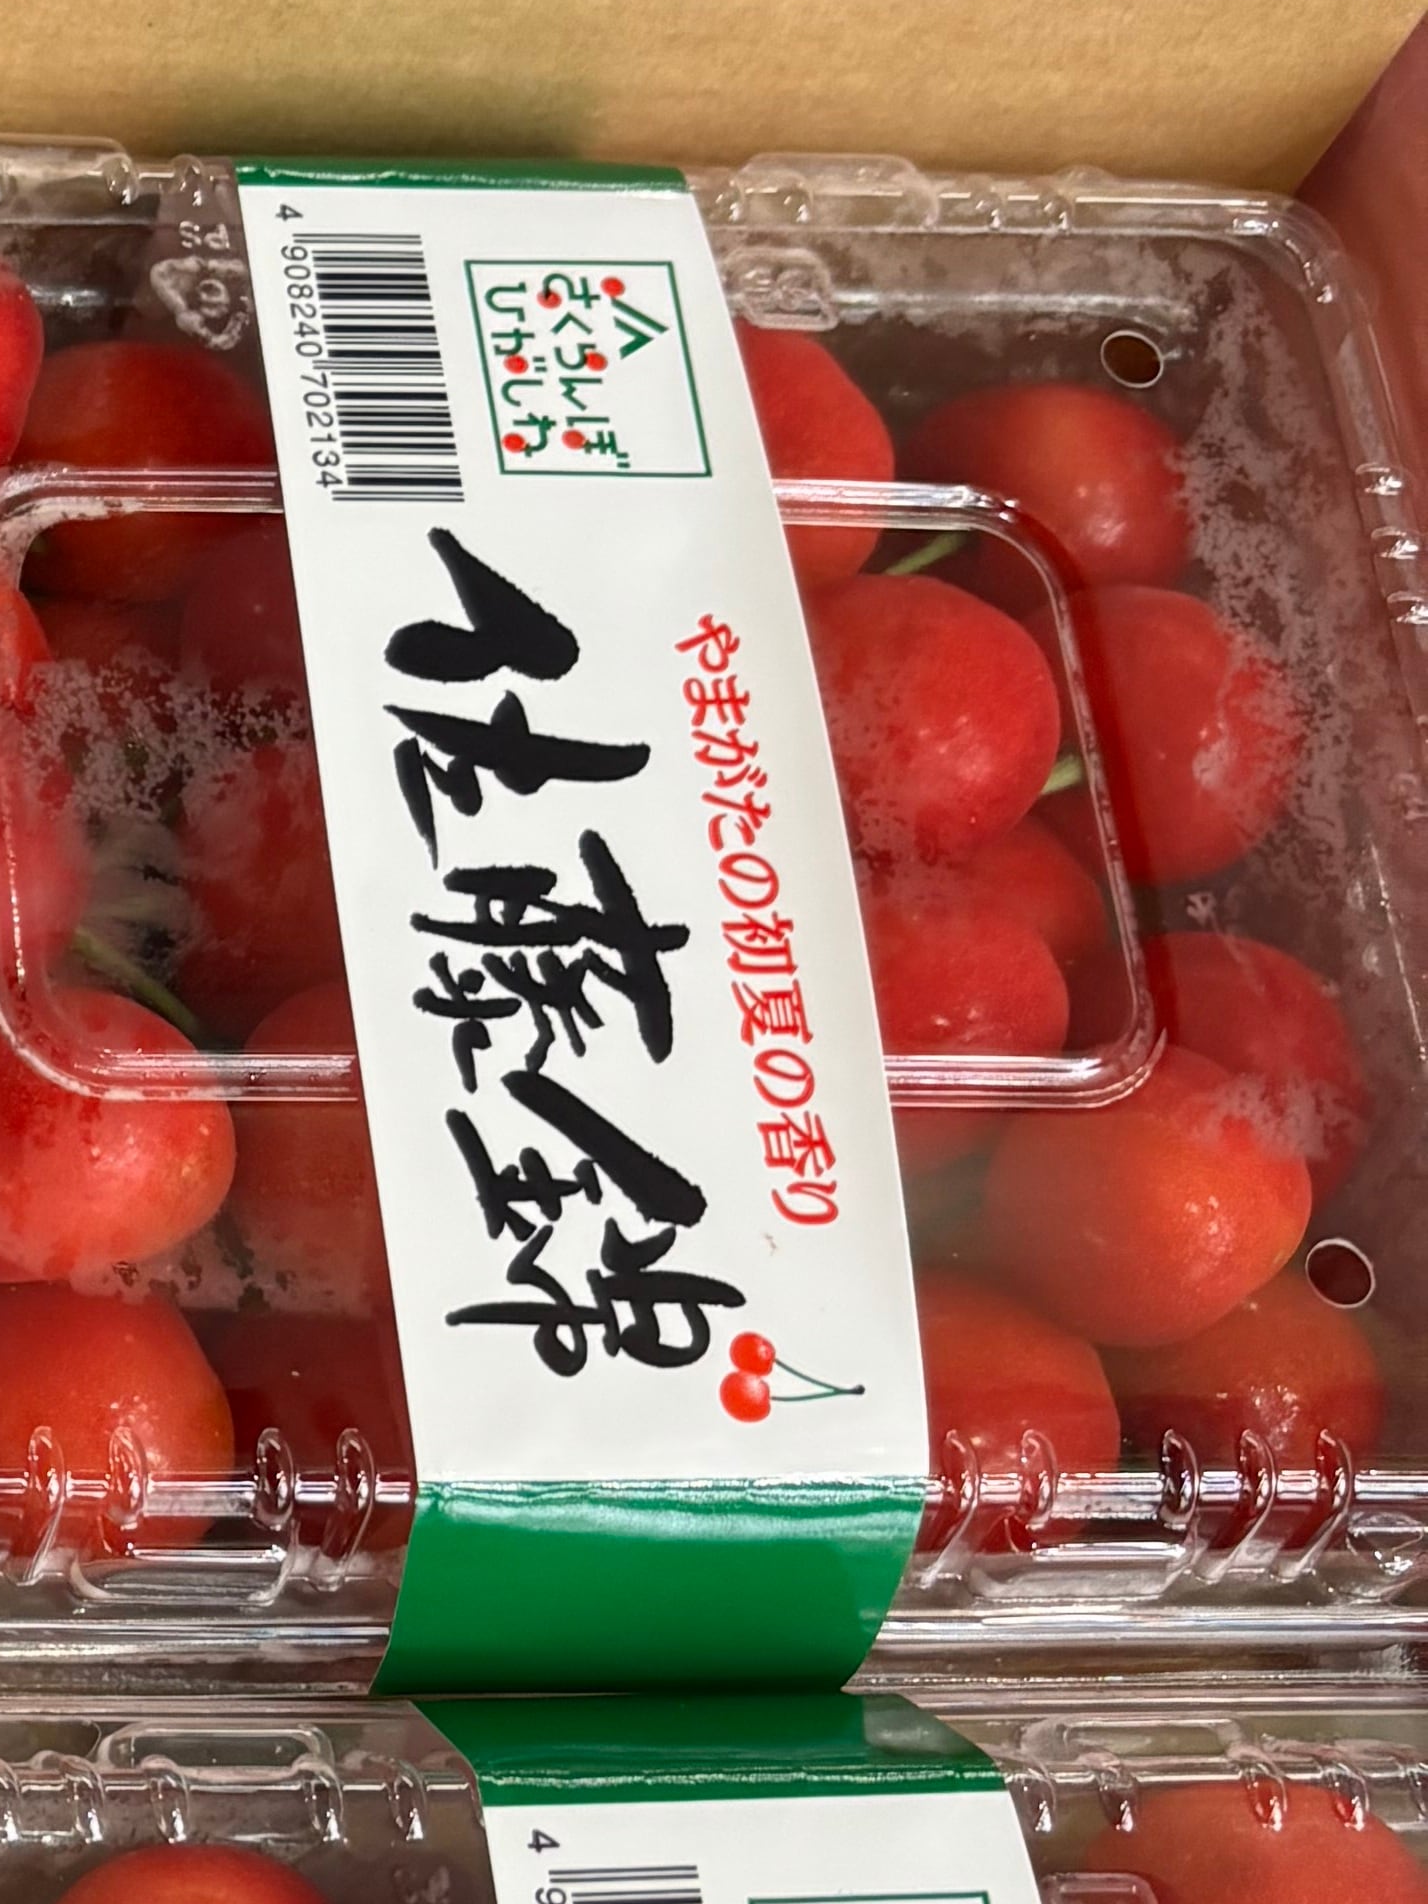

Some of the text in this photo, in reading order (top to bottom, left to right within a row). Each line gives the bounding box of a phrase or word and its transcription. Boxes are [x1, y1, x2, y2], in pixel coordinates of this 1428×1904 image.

[275, 204, 342, 488] 4 908240 702134
[537, 273, 631, 468] さくらんぼ
[384, 528, 746, 1376] 佐藤錦
[674, 614, 840, 1227] やまがたの初夏の香り
[527, 1829, 560, 1853] 4
